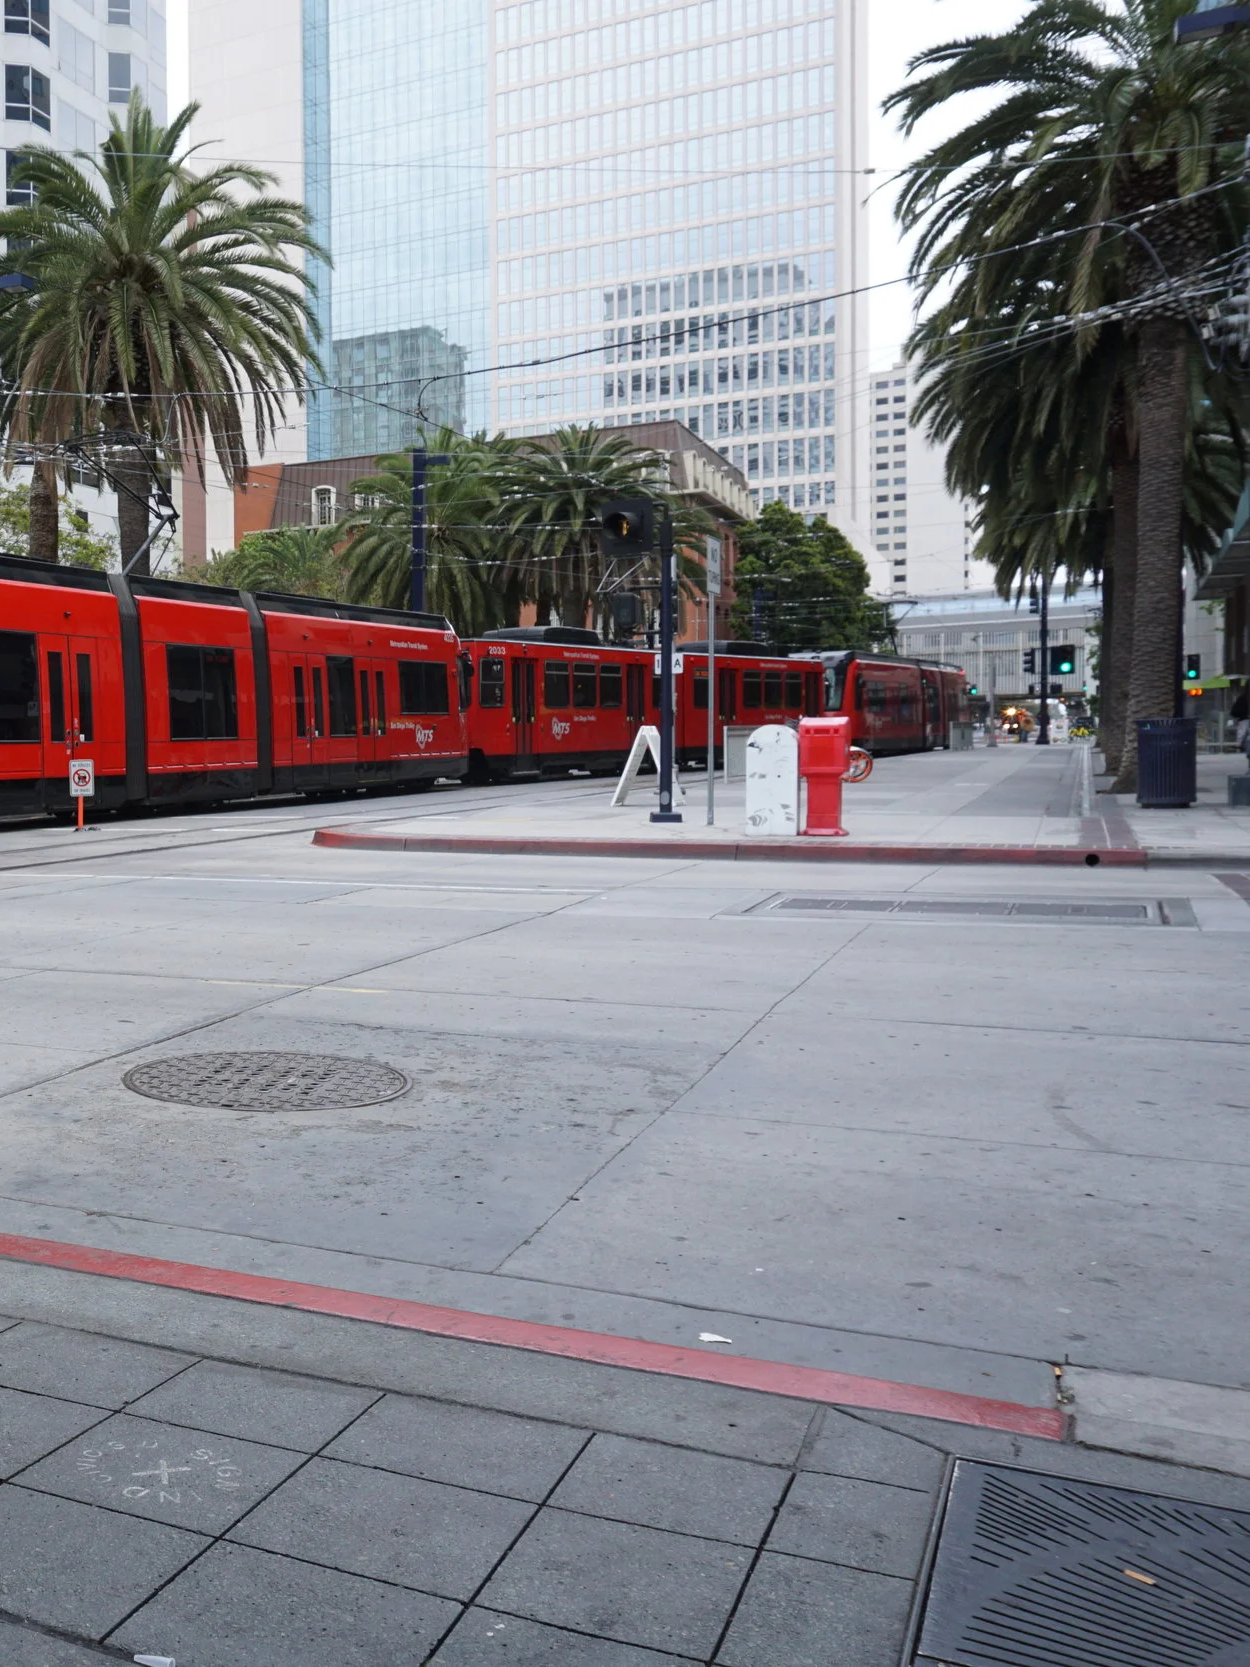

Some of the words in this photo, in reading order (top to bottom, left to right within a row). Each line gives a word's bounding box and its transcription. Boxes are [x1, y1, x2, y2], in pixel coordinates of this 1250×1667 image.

[489, 646, 506, 655] 2033
[552, 722, 571, 734] MTS
[416, 729, 434, 743] MTS
